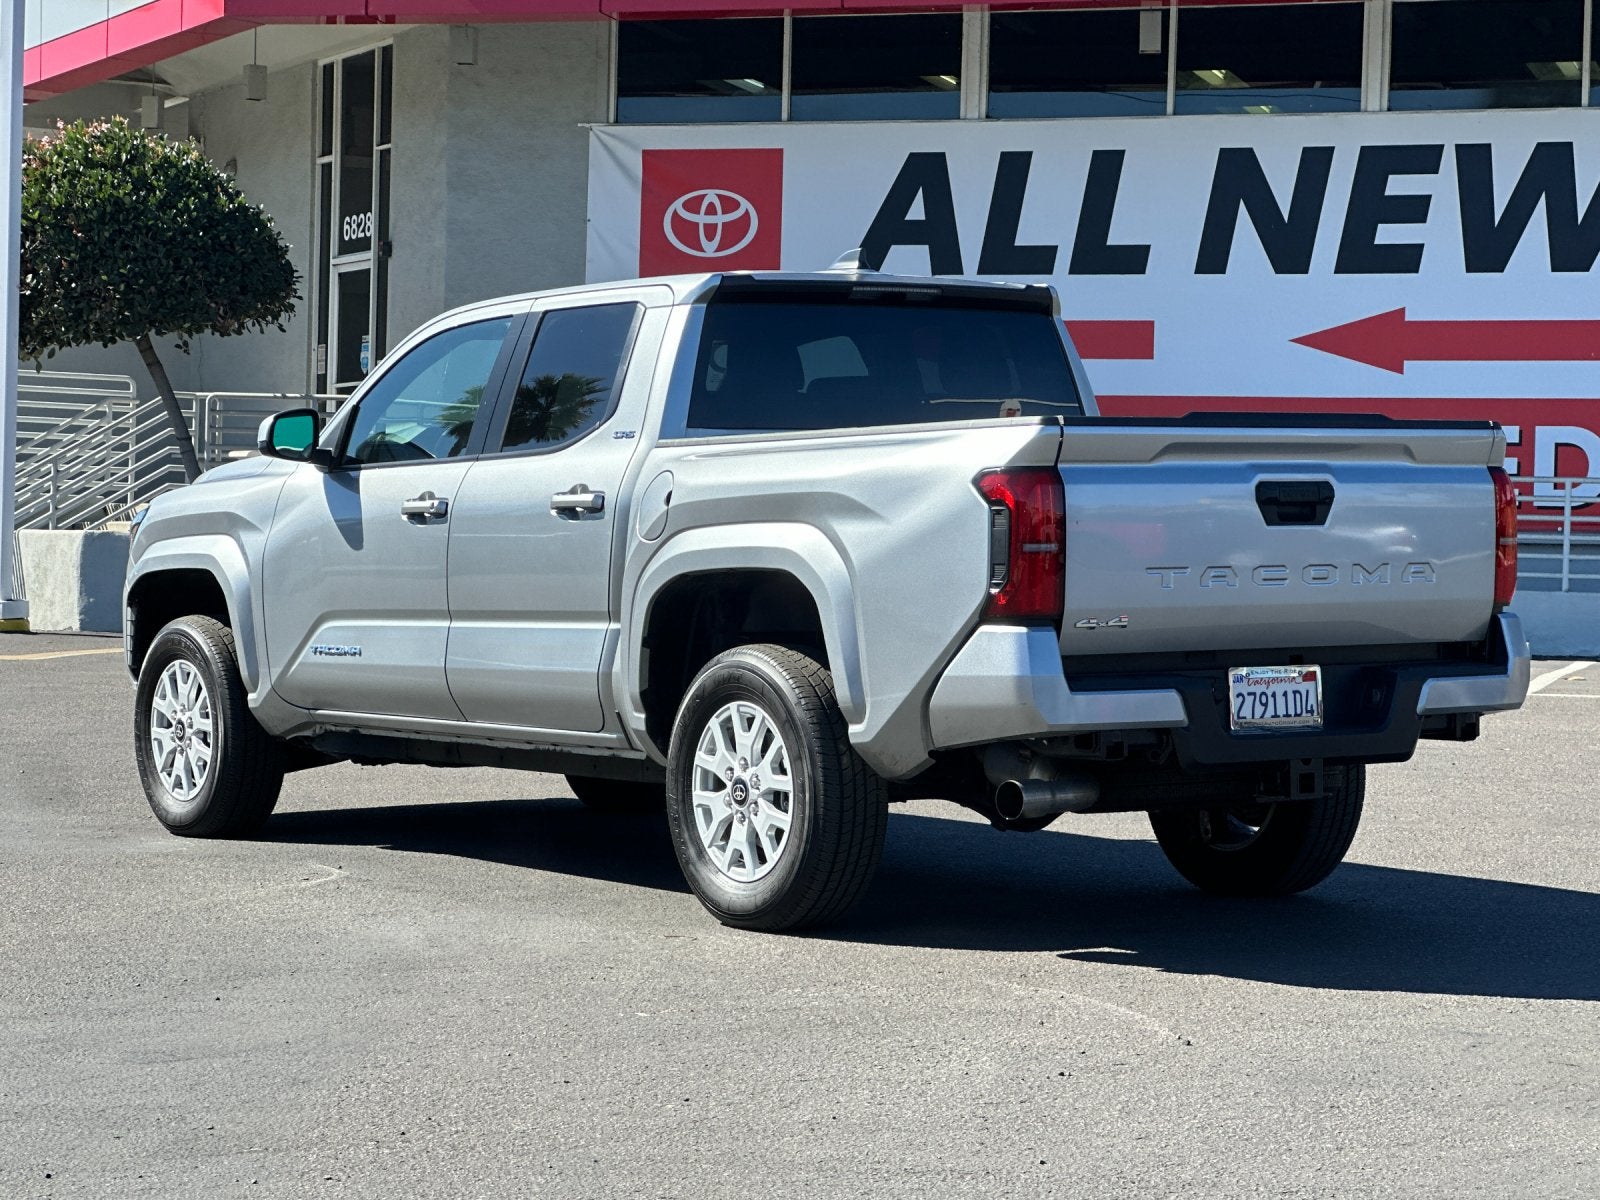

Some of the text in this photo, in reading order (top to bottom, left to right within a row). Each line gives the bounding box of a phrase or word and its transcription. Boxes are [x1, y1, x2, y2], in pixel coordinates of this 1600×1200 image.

[859, 142, 1600, 276] ALL NEW
[344, 211, 372, 241] 6828
[1145, 562, 1436, 590] TACOMA
[311, 645, 362, 657] TACOMA
[1233, 674, 1244, 684] JAN
[1247, 677, 1303, 690] California
[1236, 689, 1315, 720] 27911D4
